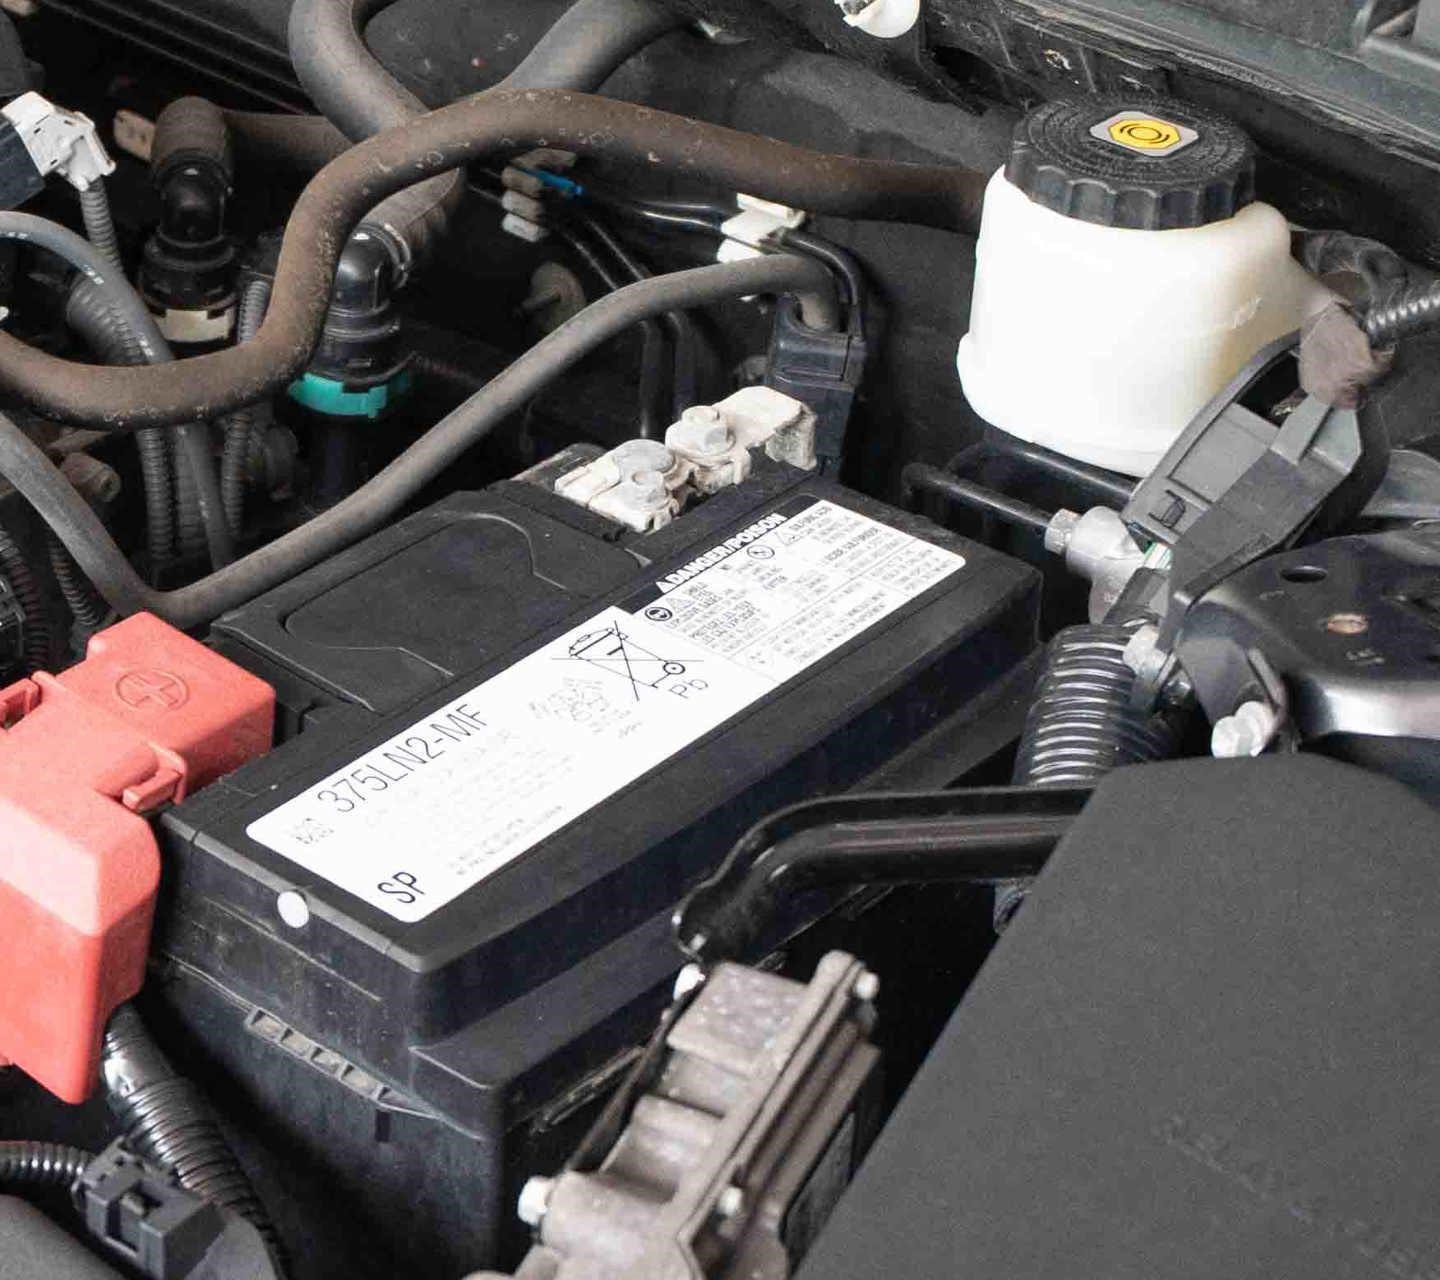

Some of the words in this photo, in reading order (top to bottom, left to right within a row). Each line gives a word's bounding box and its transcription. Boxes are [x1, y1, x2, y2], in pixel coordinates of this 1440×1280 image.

[665, 512, 788, 586] DANGER/POISON
[668, 678, 709, 699] Pb
[317, 703, 487, 813] 375LN2-MF
[377, 871, 426, 914] SP
